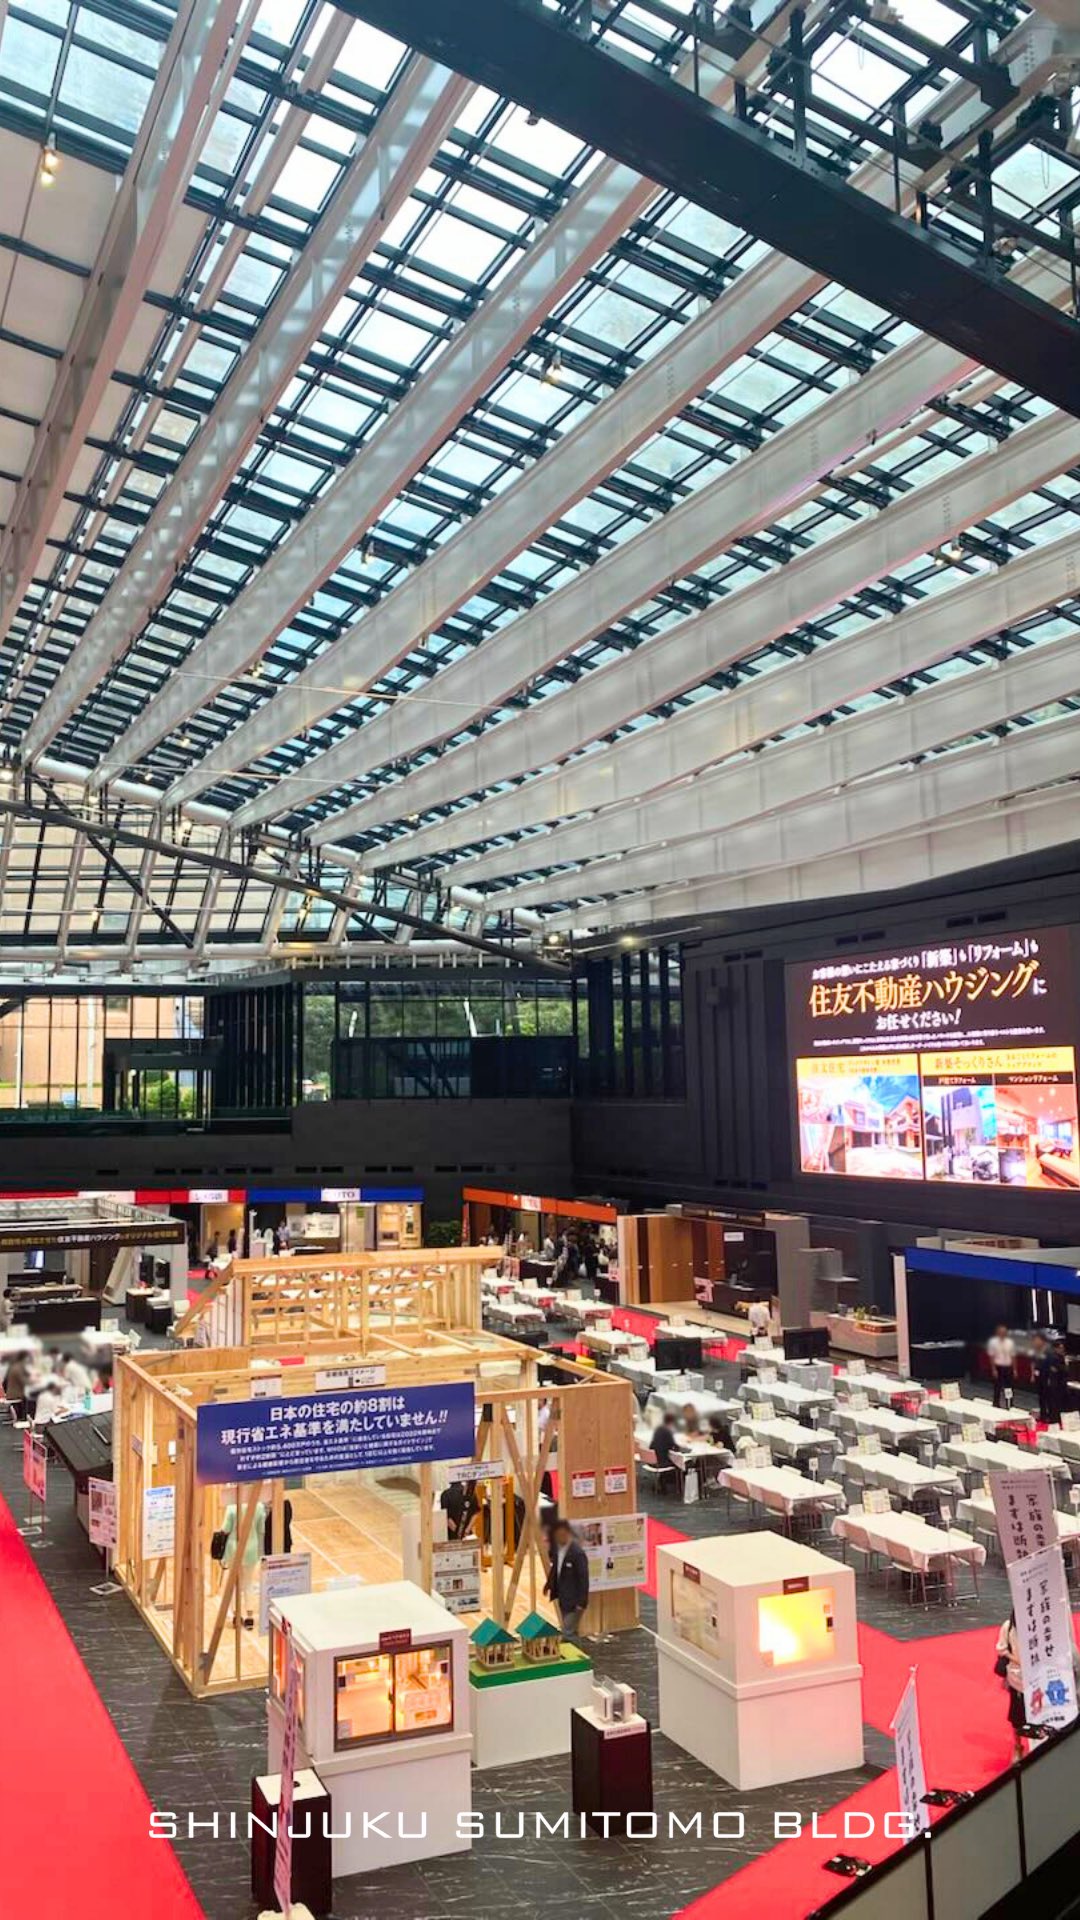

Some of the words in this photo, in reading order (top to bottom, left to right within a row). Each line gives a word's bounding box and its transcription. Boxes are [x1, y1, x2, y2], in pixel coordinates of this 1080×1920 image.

[809, 959, 1048, 1017] 住友不動産ハウジングに
[270, 1396, 406, 1422] 日本の住宅の約8割は
[1039, 1579, 1055, 1658] 家族の幸せ
